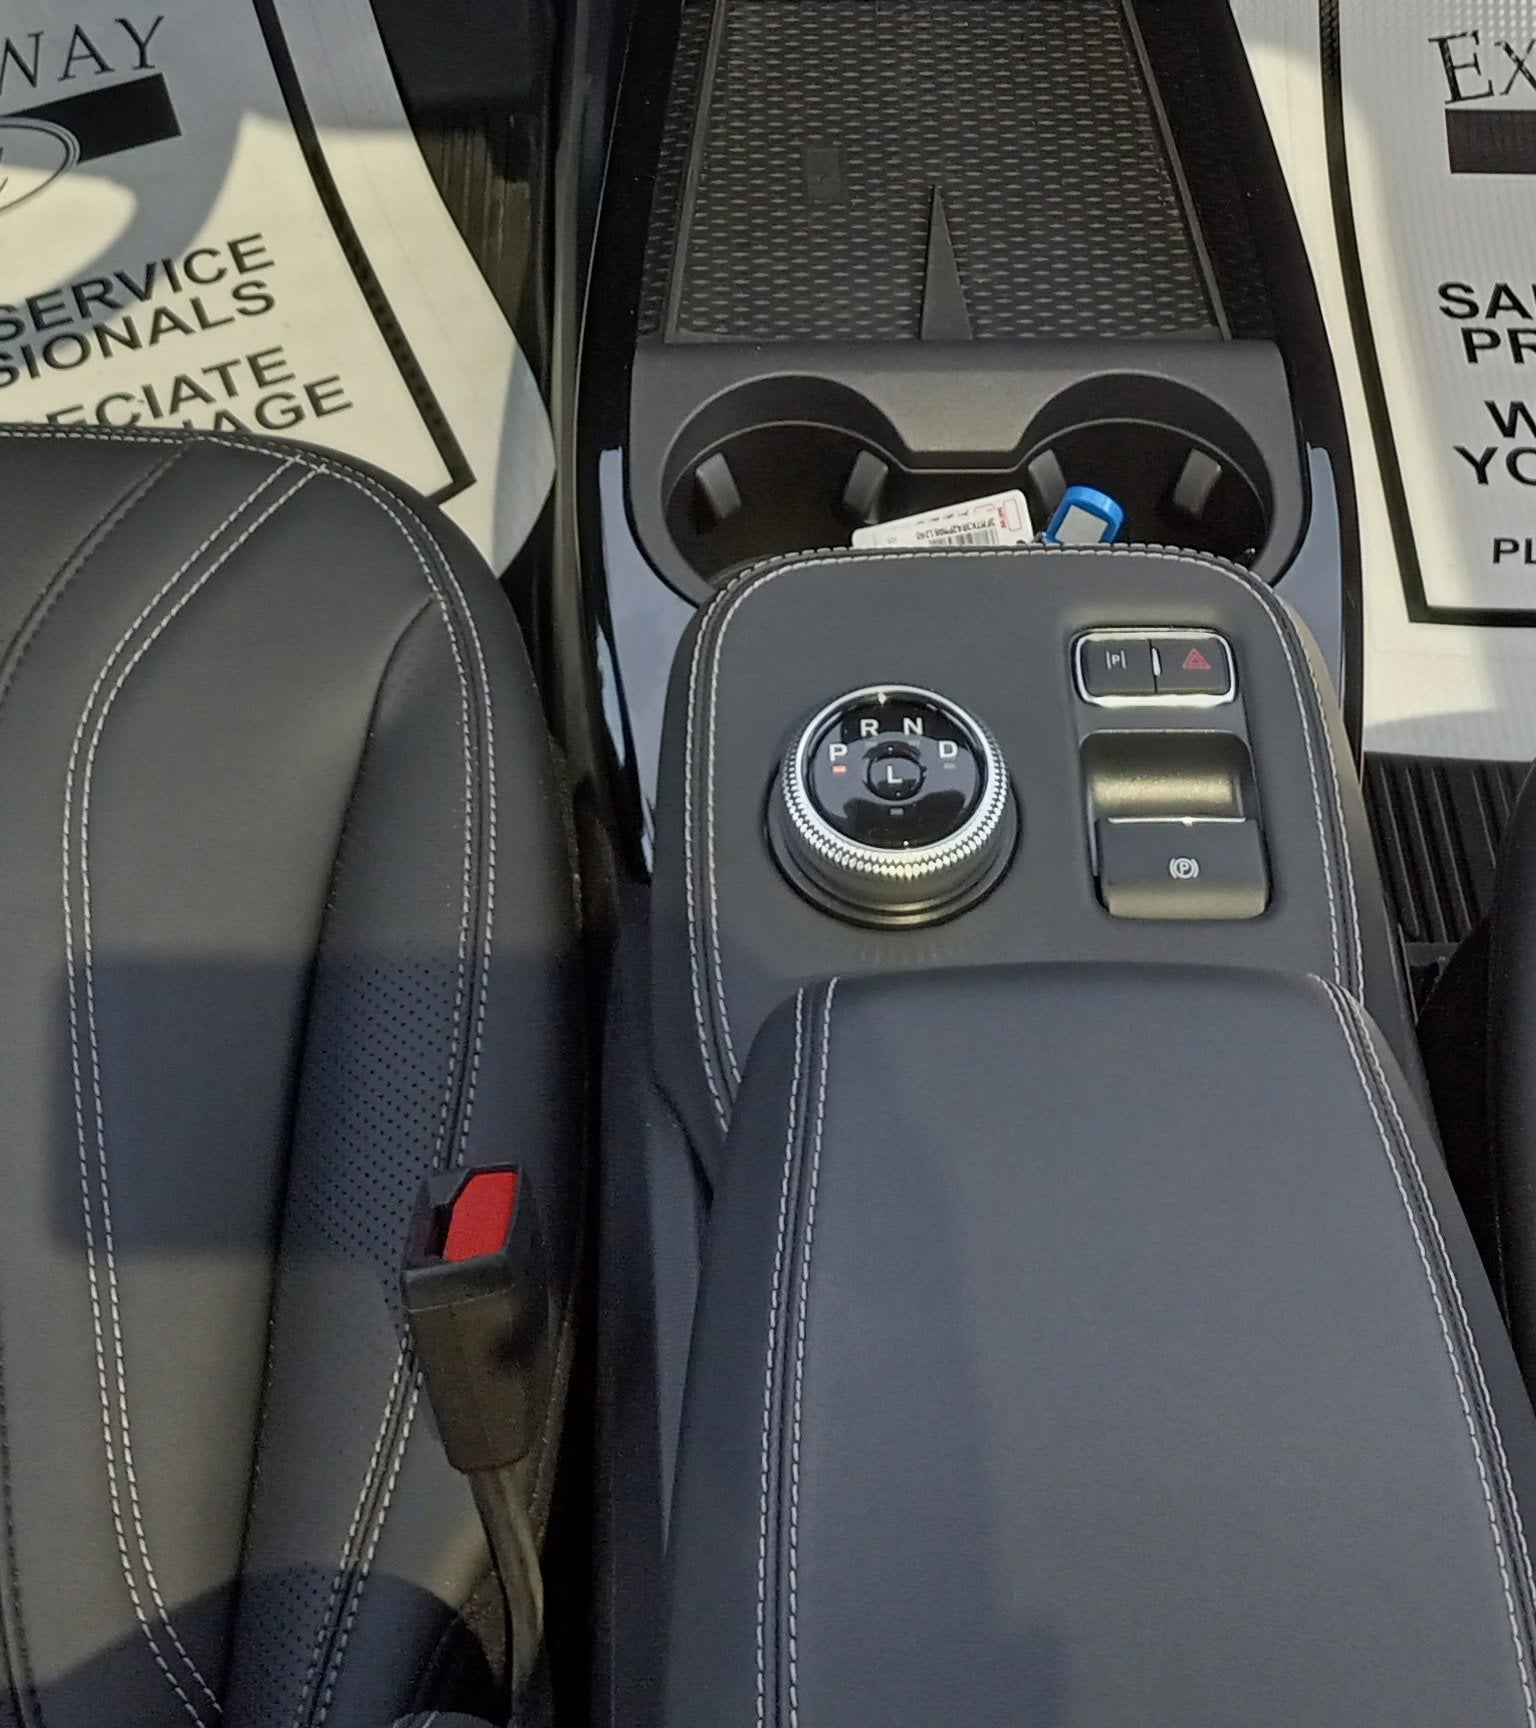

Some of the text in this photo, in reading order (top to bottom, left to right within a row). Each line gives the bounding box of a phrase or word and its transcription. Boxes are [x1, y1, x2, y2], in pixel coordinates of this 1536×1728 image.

[860, 717, 923, 738] R N
[830, 741, 958, 762] P D
[887, 765, 903, 784] L
